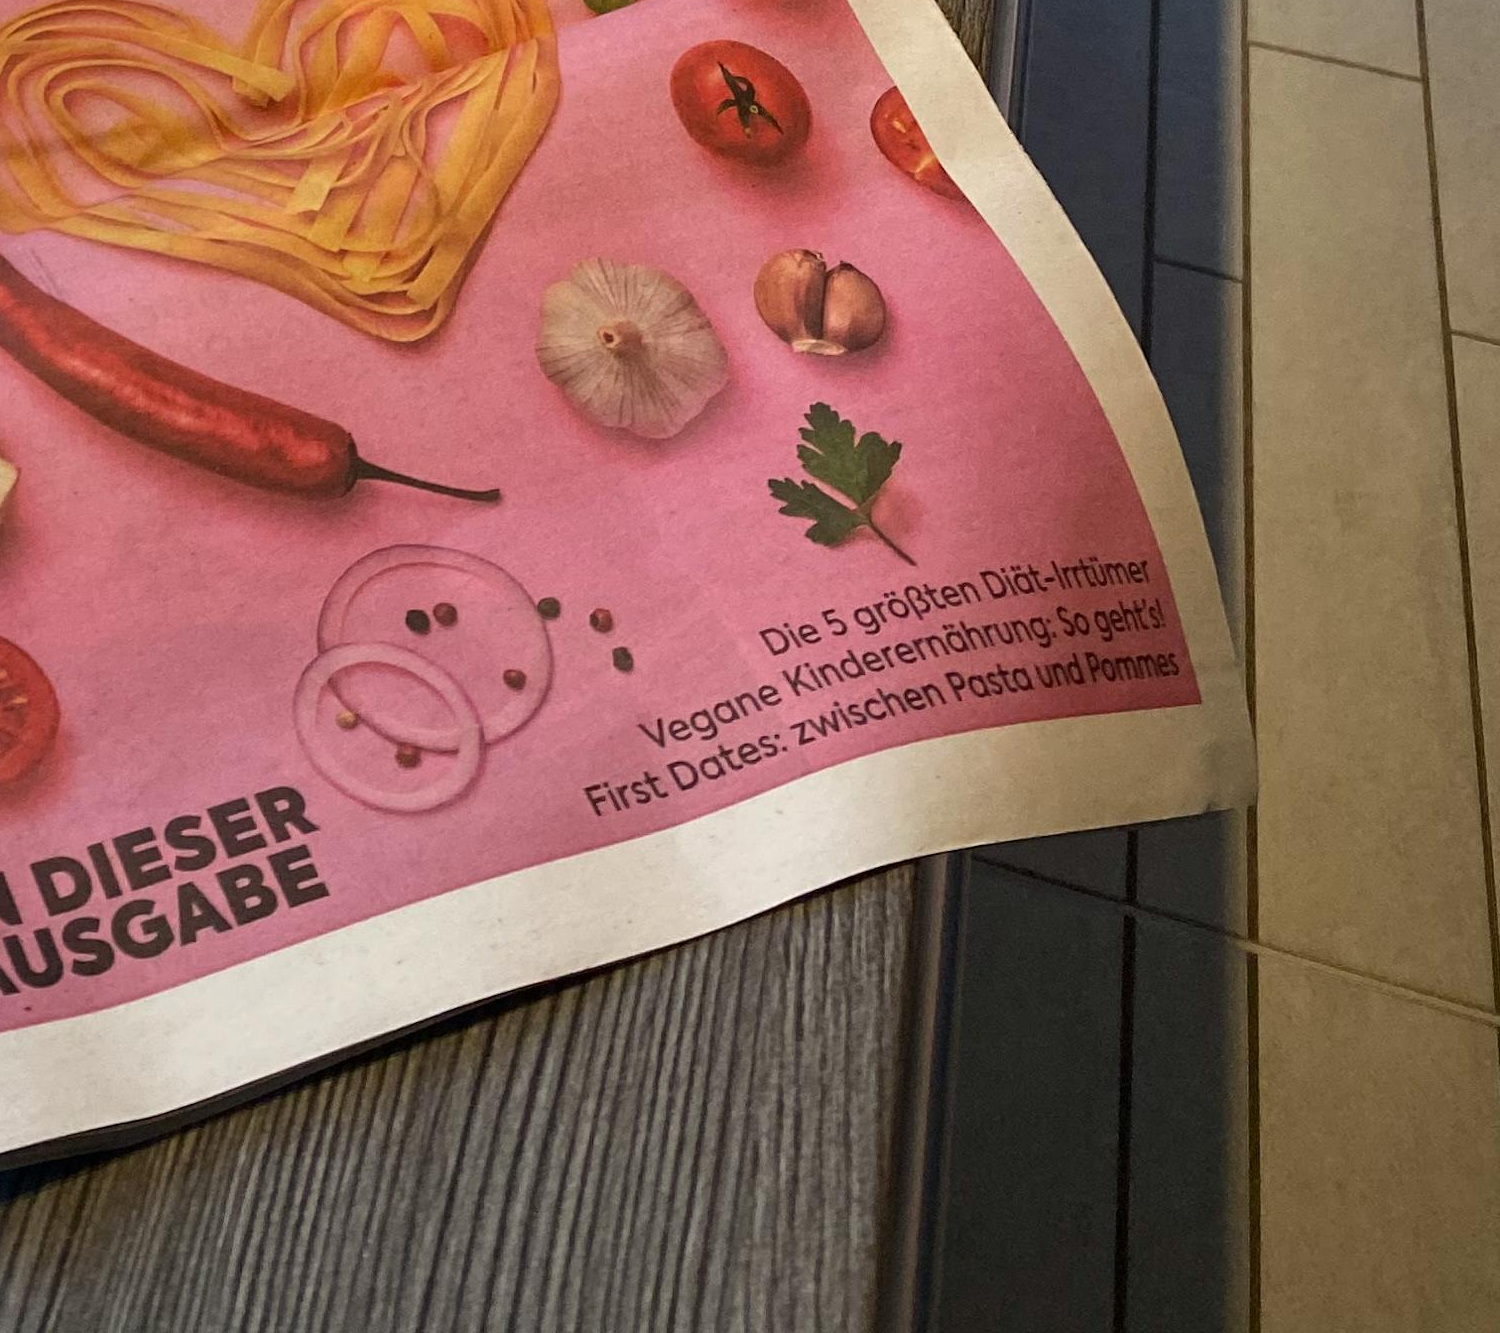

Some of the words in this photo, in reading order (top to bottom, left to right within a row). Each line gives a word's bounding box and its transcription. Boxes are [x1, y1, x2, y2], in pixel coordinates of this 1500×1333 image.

[636, 682, 781, 748] Vegane
[782, 613, 1056, 698] Kinderernährung:
[1057, 605, 1090, 638] So
[1094, 601, 1166, 642] geht's!
[758, 622, 818, 658] Die
[828, 608, 848, 637] 5
[854, 574, 980, 639] größten
[980, 556, 1150, 600] Diät-Irrtümer
[583, 771, 661, 817] First
[667, 731, 789, 793] Dates:
[797, 682, 944, 747] zwischen
[951, 663, 1032, 701] Pasta
[1035, 653, 1084, 690] und
[1088, 646, 1181, 685] Pommes
[29, 785, 321, 917] DIESER
